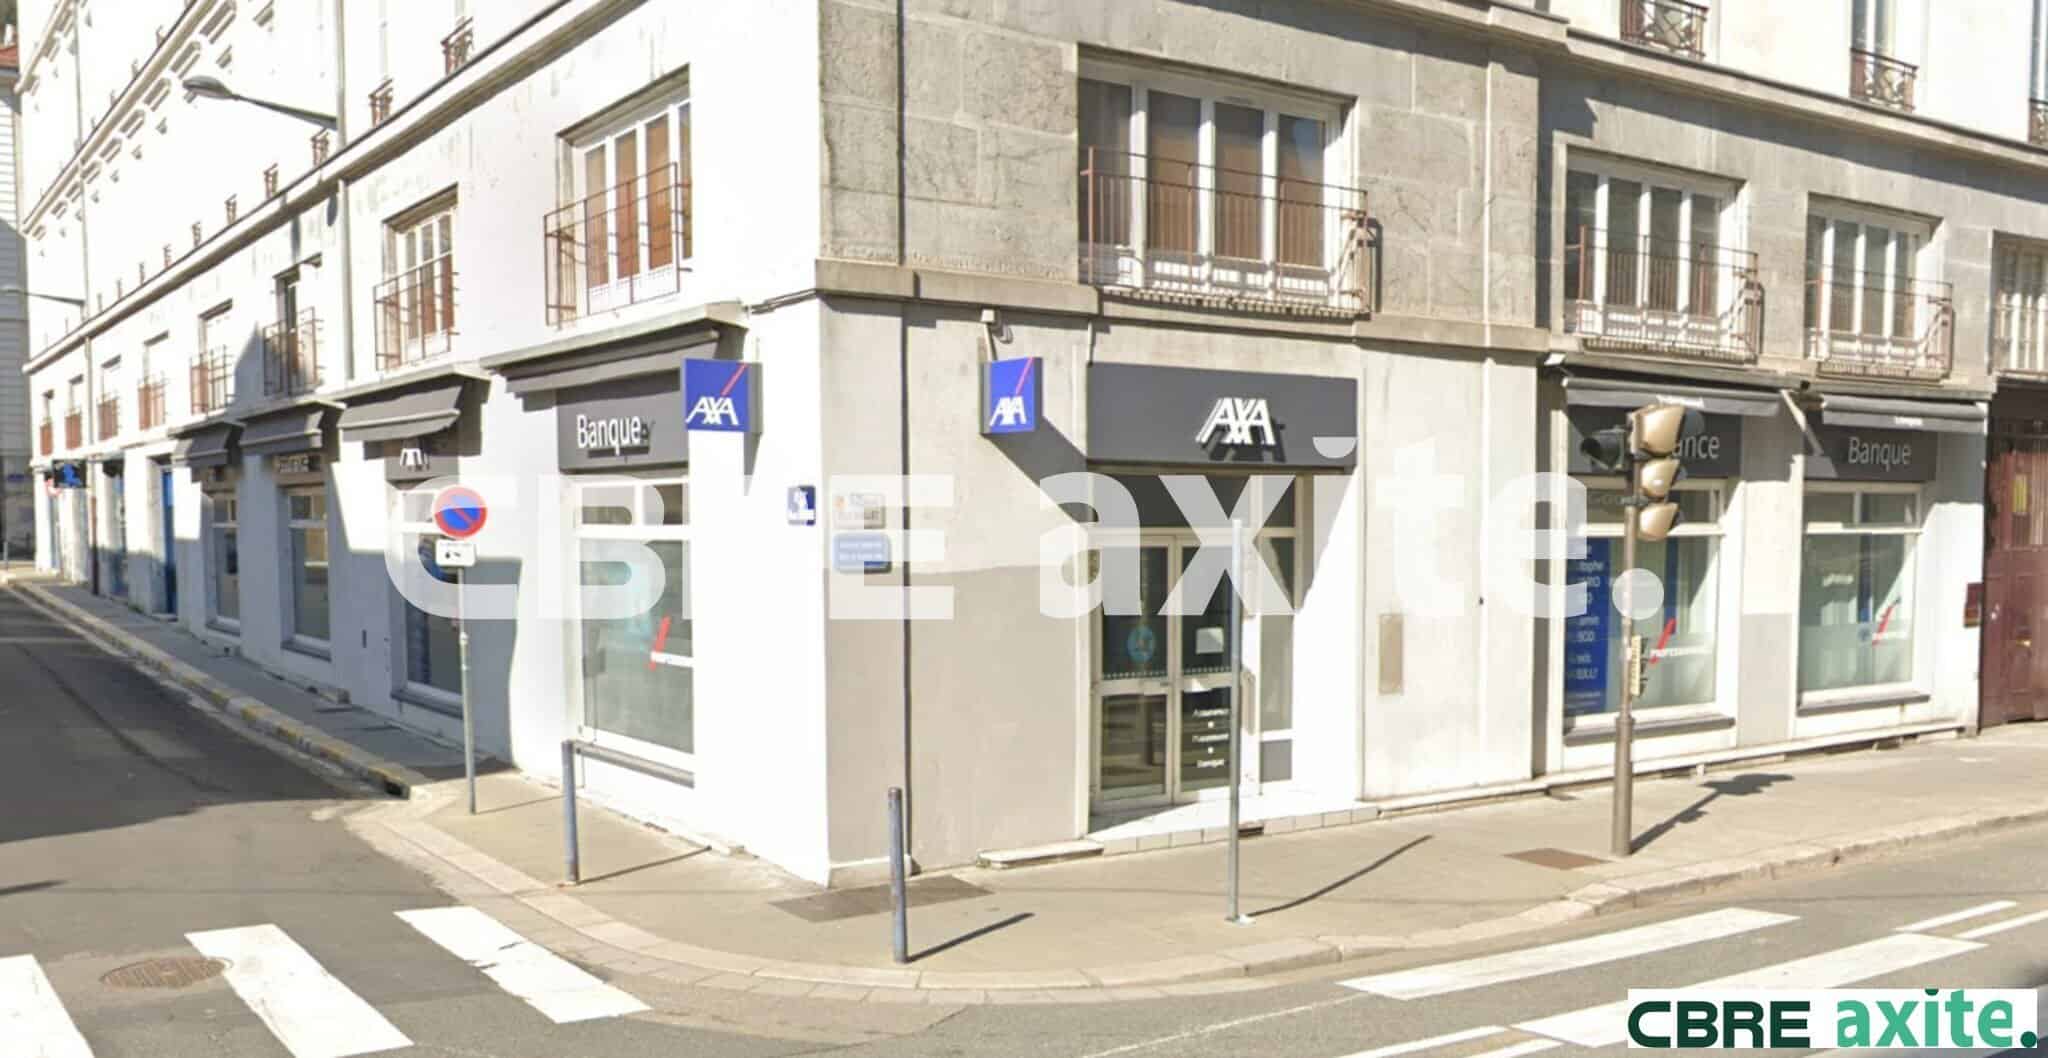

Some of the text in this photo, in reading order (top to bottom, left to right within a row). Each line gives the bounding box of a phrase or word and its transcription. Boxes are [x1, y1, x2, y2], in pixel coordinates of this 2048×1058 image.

[685, 396, 739, 426] AXA
[989, 396, 1027, 427] AXA
[1195, 397, 1276, 446] AXA
[576, 413, 641, 456] Banque
[1849, 436, 1912, 472] Banque
